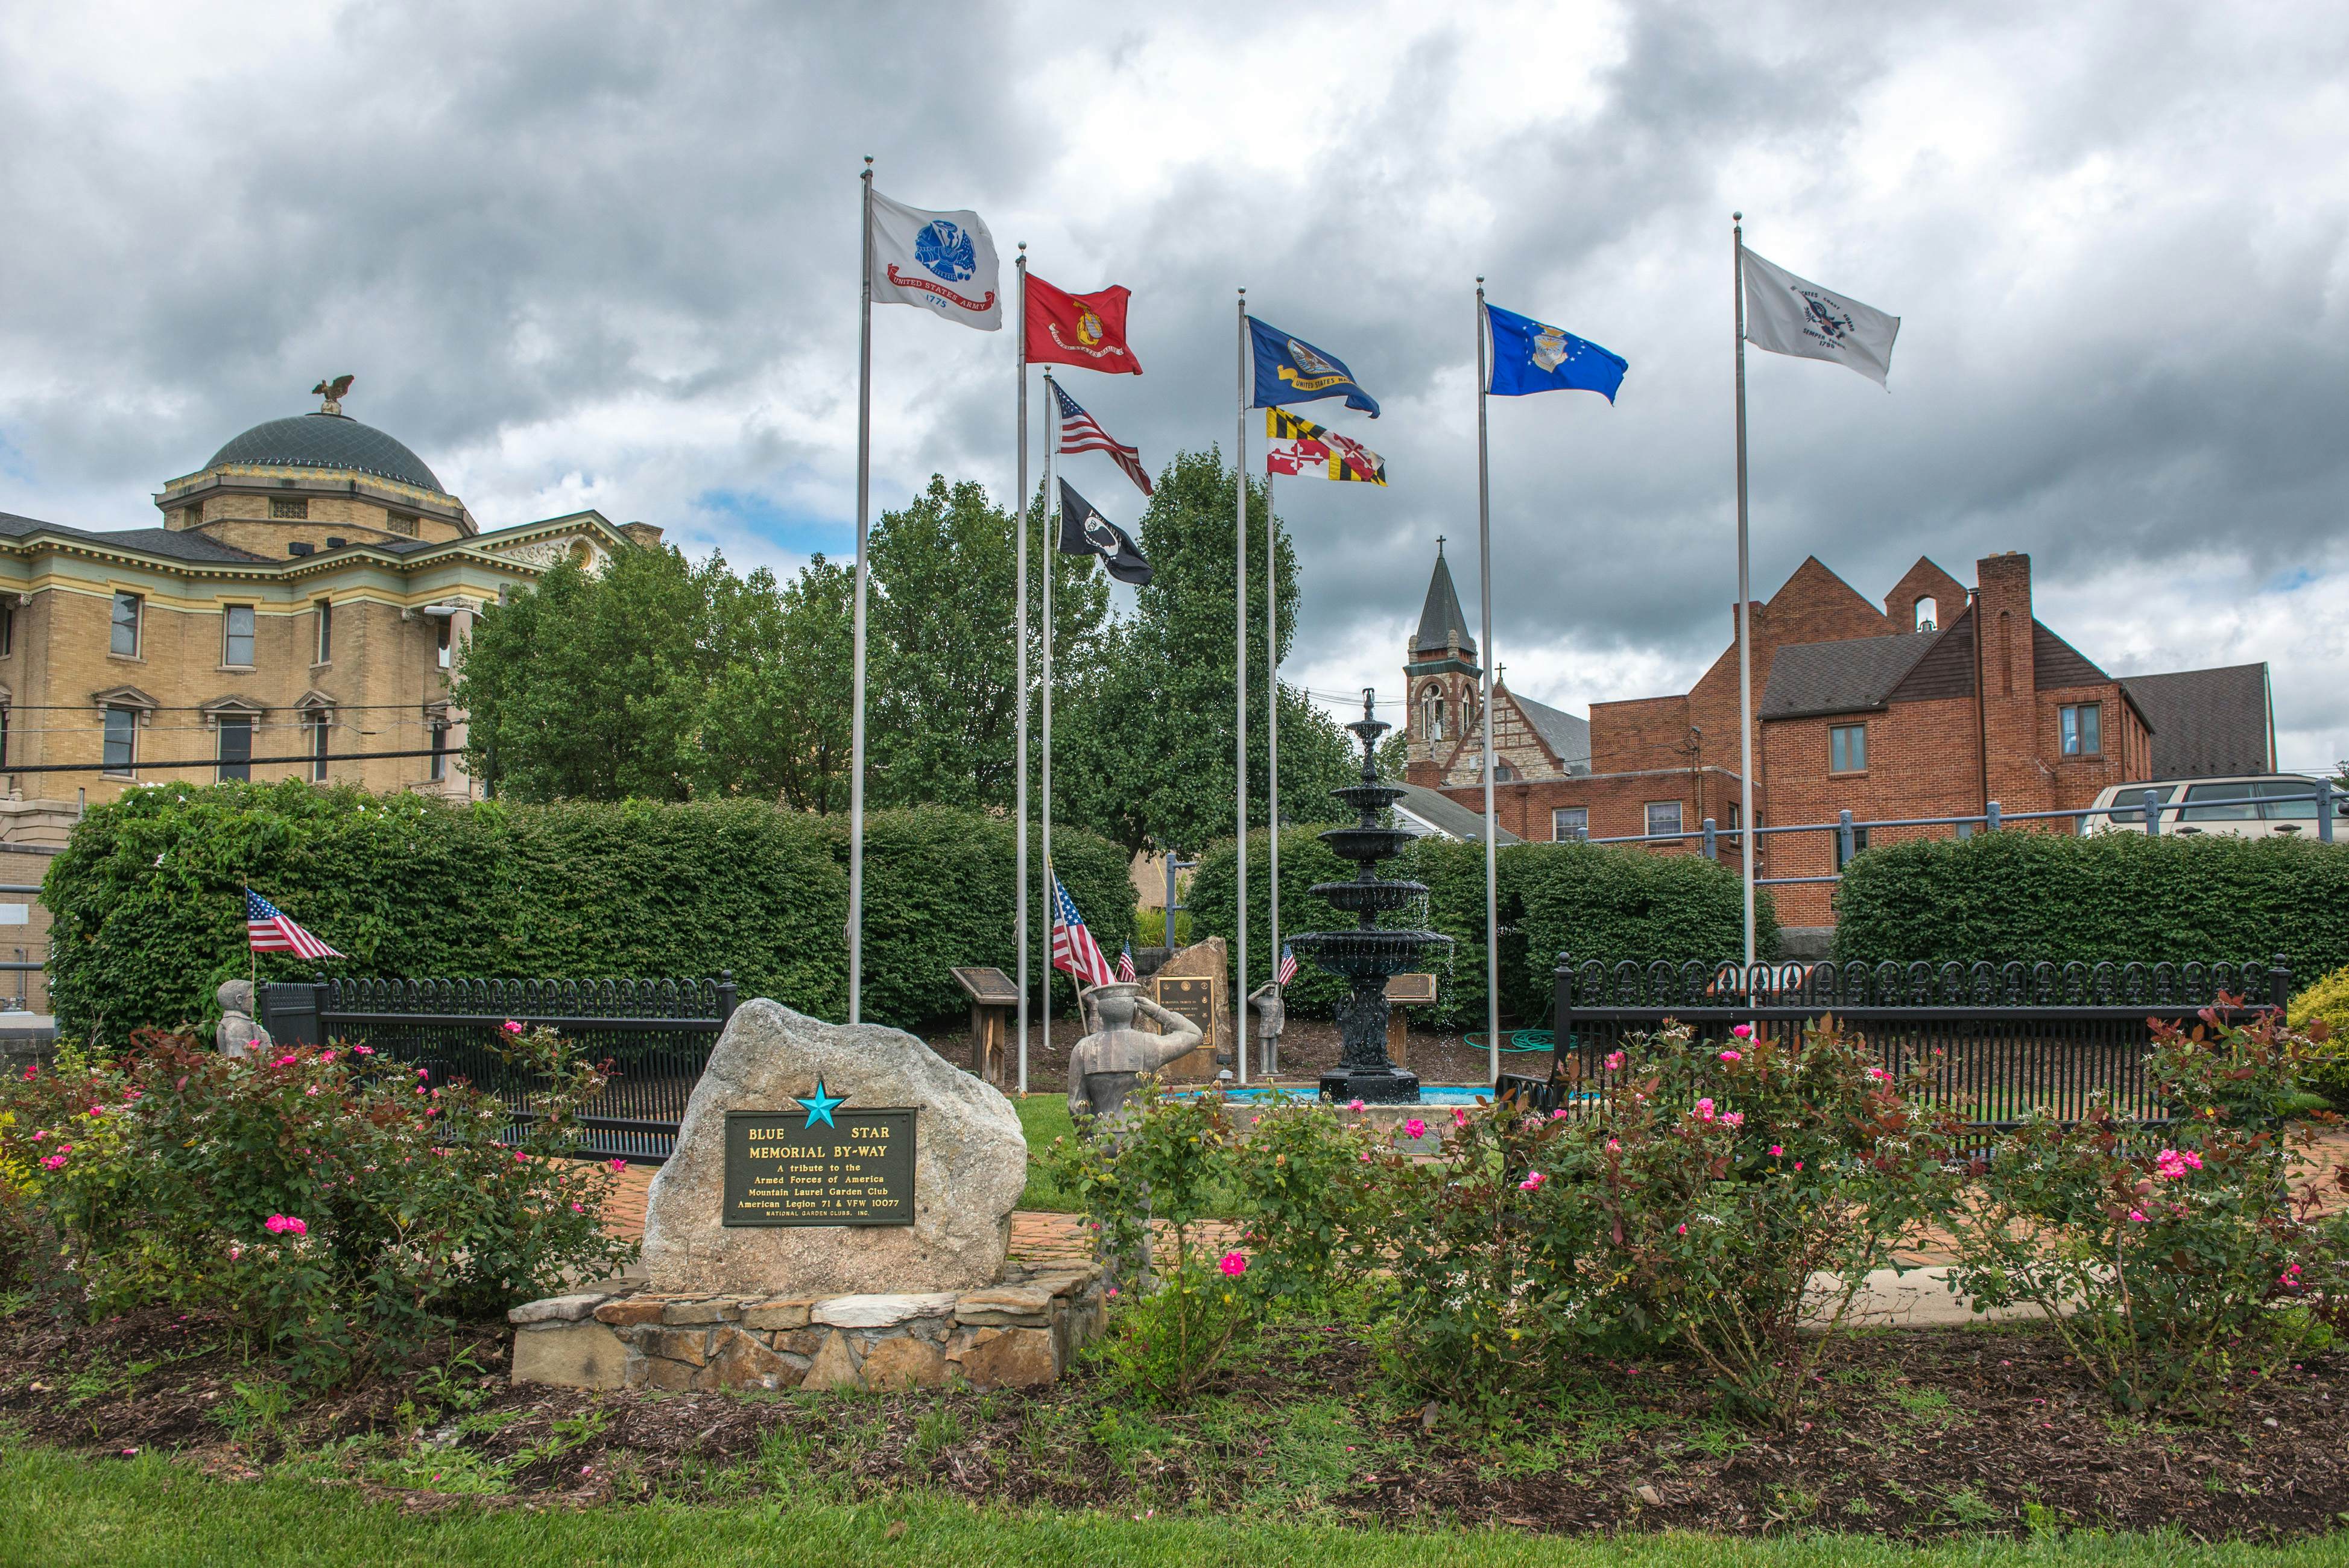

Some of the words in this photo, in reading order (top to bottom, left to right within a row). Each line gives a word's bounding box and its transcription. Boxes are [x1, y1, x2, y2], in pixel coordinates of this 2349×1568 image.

[893, 277, 922, 286] UNITED
[925, 282, 958, 300] STATES
[960, 301, 985, 310] ARMY
[926, 294, 947, 308] 1775
[1843, 314, 1855, 332] GUARD
[1803, 328, 1826, 340] SEMPER
[1052, 332, 1071, 350] UNITED
[1100, 346, 1118, 357] MARINE
[1296, 380, 1314, 388] UNITED
[1315, 378, 1335, 388] STATES
[749, 1128, 784, 1140] BLUE
[851, 1127, 890, 1139] STAR
[750, 1146, 825, 1158] MEMORIAL
[833, 1146, 887, 1157] BY-WAY
[748, 1188, 789, 1197] Mountain
[786, 1200, 816, 1209] Legion
